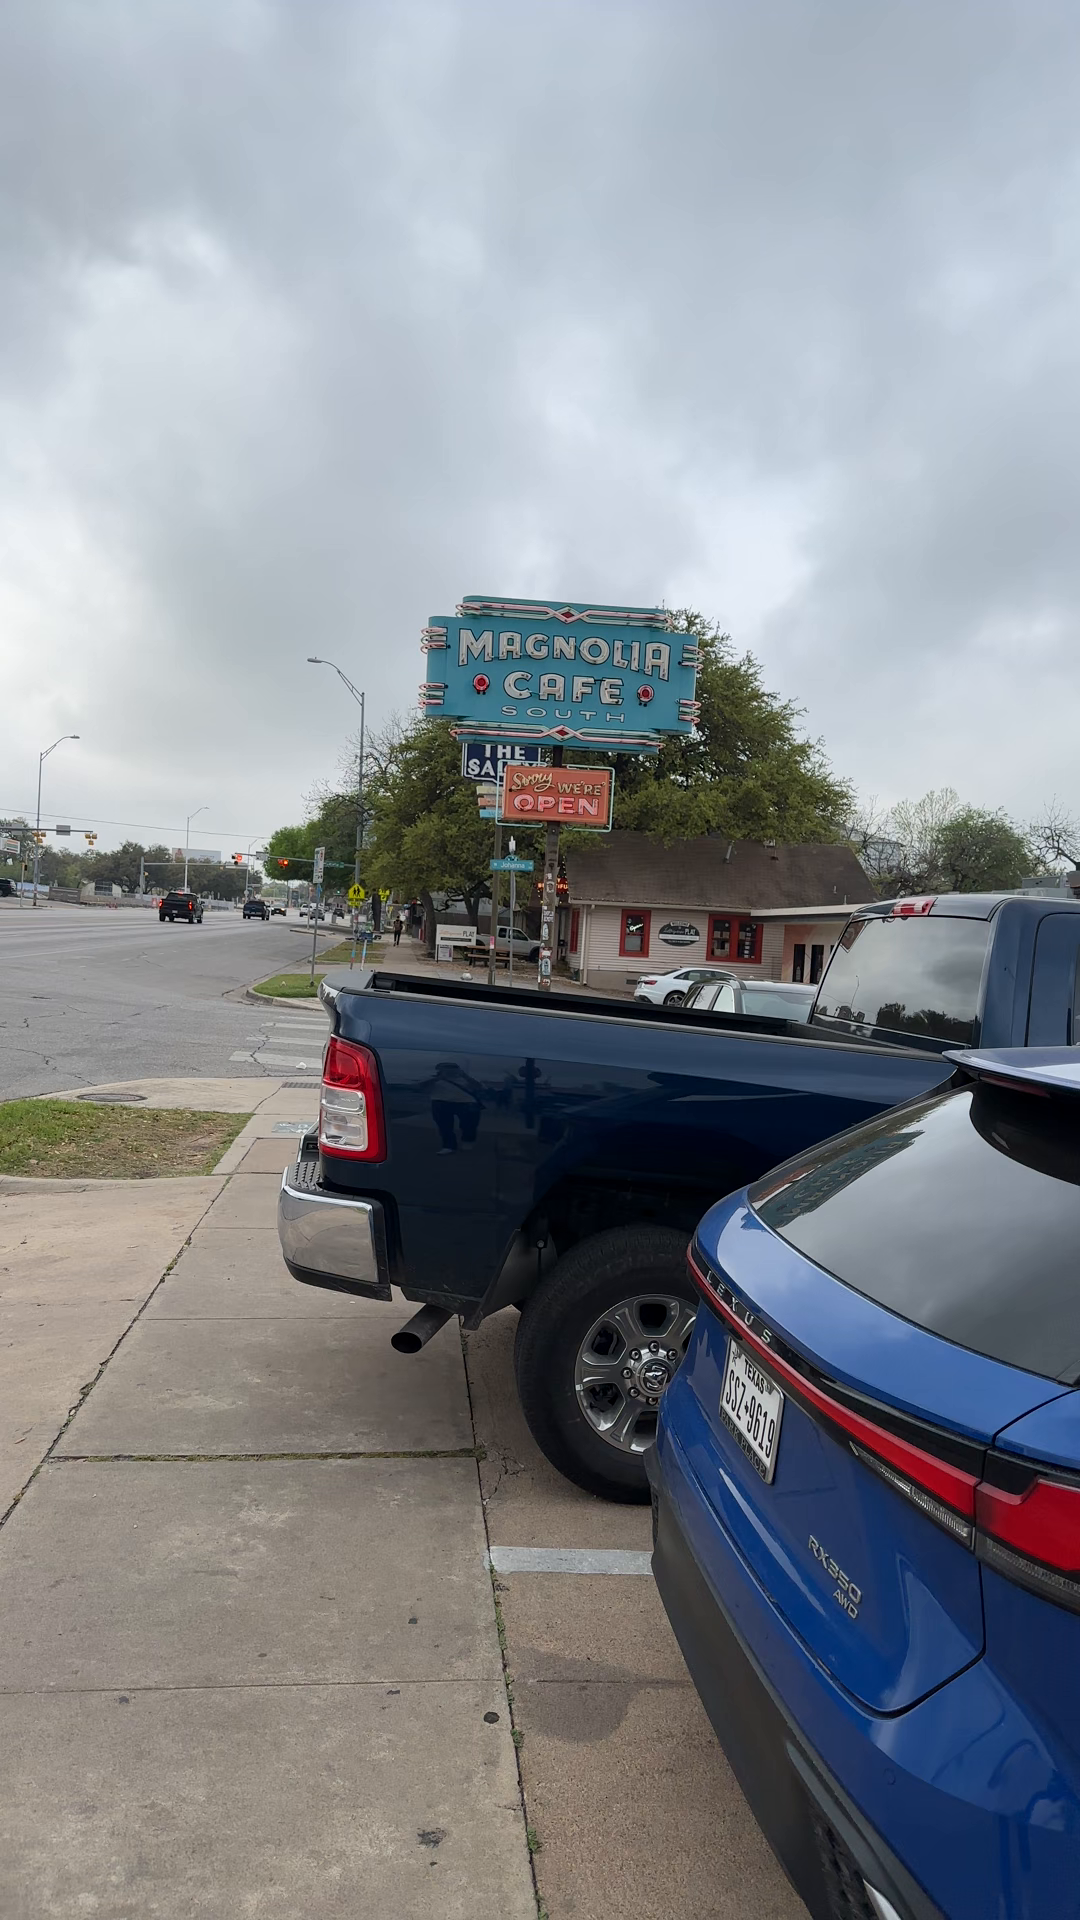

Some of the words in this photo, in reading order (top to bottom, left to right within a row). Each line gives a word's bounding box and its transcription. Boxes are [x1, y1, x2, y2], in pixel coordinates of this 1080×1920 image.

[458, 628, 671, 681] MAGNOLIA
[503, 671, 624, 705] CAFE
[501, 705, 625, 723] SOUTH
[482, 744, 526, 760] THE
[513, 794, 599, 816] OPEN
[706, 1270, 772, 1344] LEXUS
[744, 1358, 765, 1395] TEXAS
[833, 1589, 858, 1619] AWD
